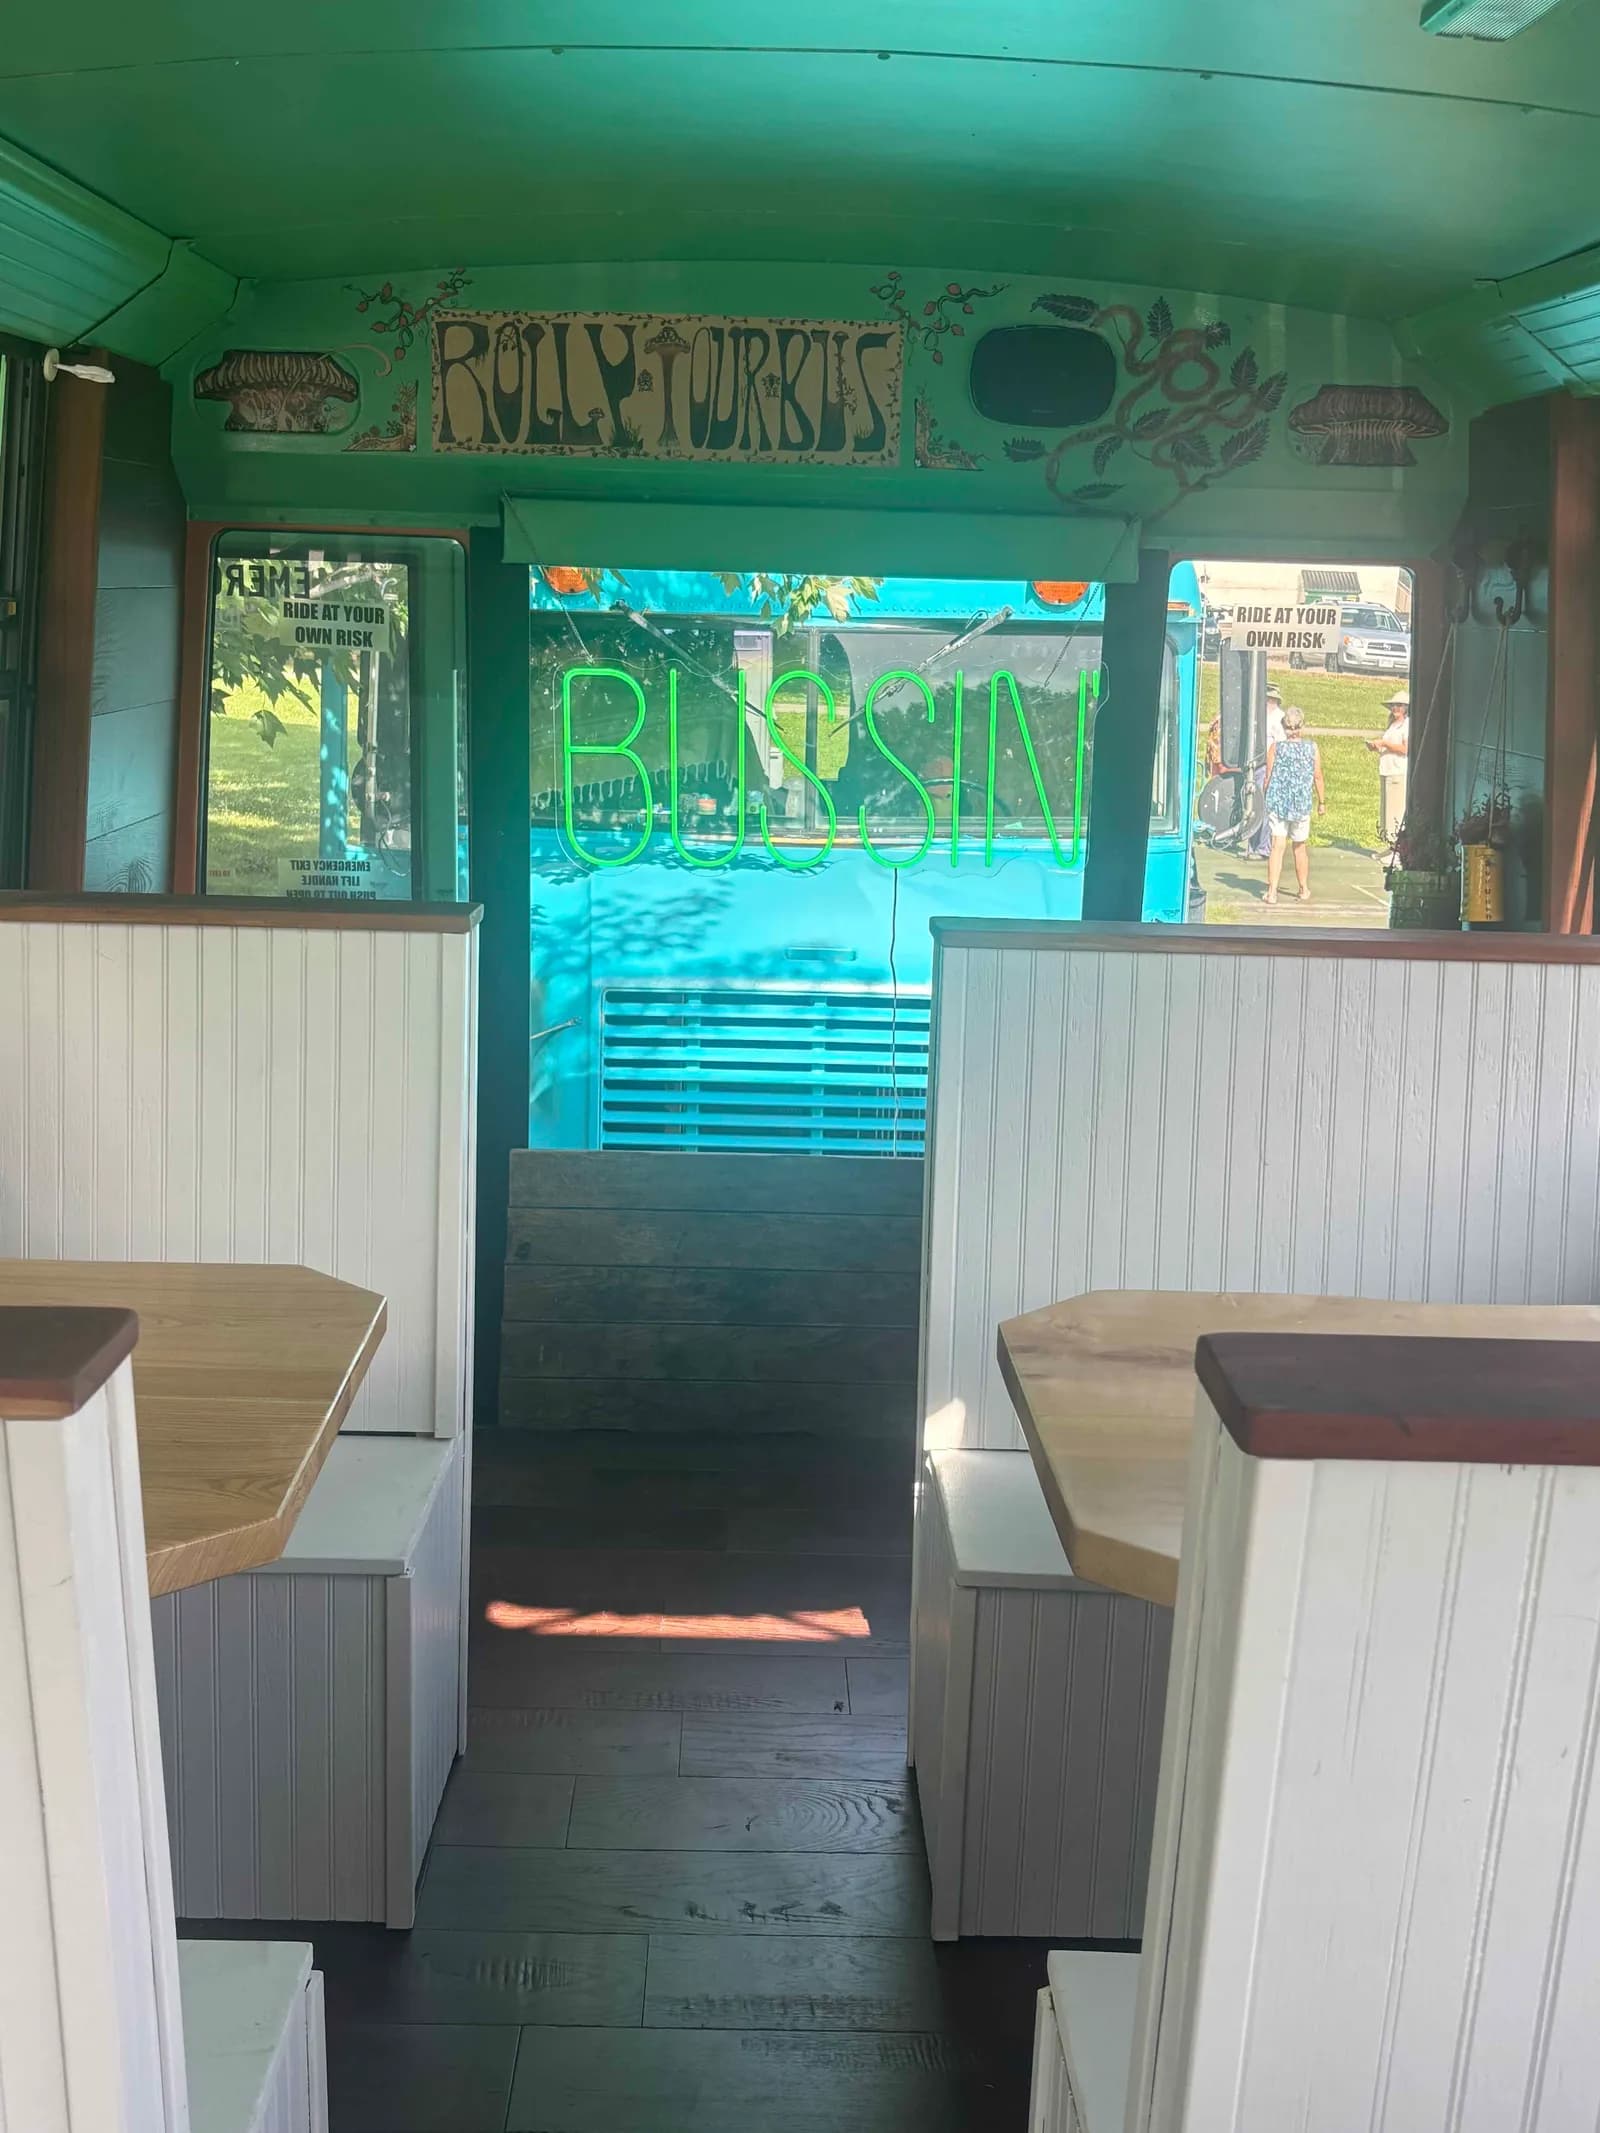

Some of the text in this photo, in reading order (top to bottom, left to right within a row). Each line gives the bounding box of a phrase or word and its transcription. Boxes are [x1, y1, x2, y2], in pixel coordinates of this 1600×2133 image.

[435, 319, 897, 453] ROLLY TOUR BUS
[283, 601, 385, 625] RIDE AT YOUR
[1236, 606, 1337, 625] RIDE AT YOUR
[295, 626, 374, 649] OWN RISK
[1246, 630, 1323, 649] OWN RISK
[562, 667, 1101, 868] BUSSIN'
